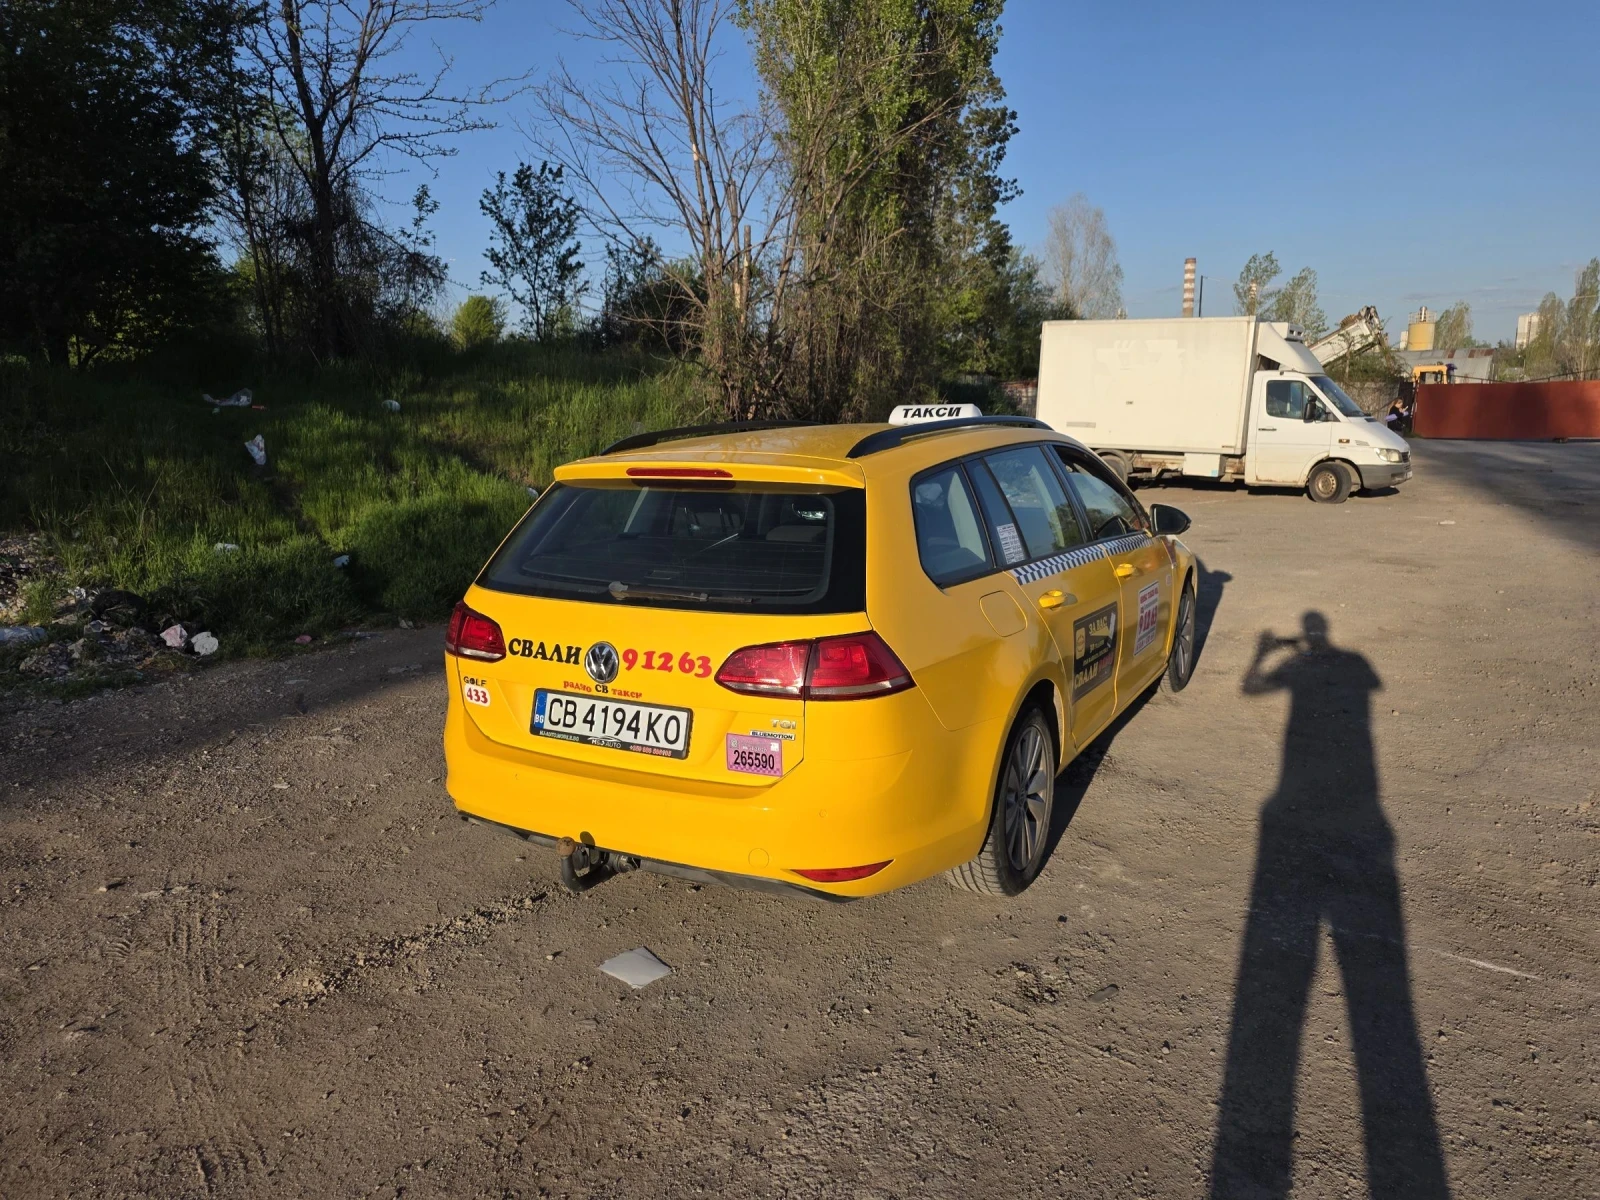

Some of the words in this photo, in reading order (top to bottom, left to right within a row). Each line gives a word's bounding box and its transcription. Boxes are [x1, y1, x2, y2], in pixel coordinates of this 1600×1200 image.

[903, 407, 961, 418] ТАКСИ
[508, 638, 582, 665] СВАЛИ
[622, 648, 712, 678] 91263
[463, 676, 487, 686] GOLF
[563, 680, 592, 693] радио
[595, 684, 609, 694] СВ
[611, 688, 642, 699] такси
[467, 687, 488, 704] 433
[534, 714, 544, 724] BG
[751, 731, 793, 740] BLUEMOTION
[605, 741, 621, 749] AUTO
[733, 749, 775, 770] 265590
